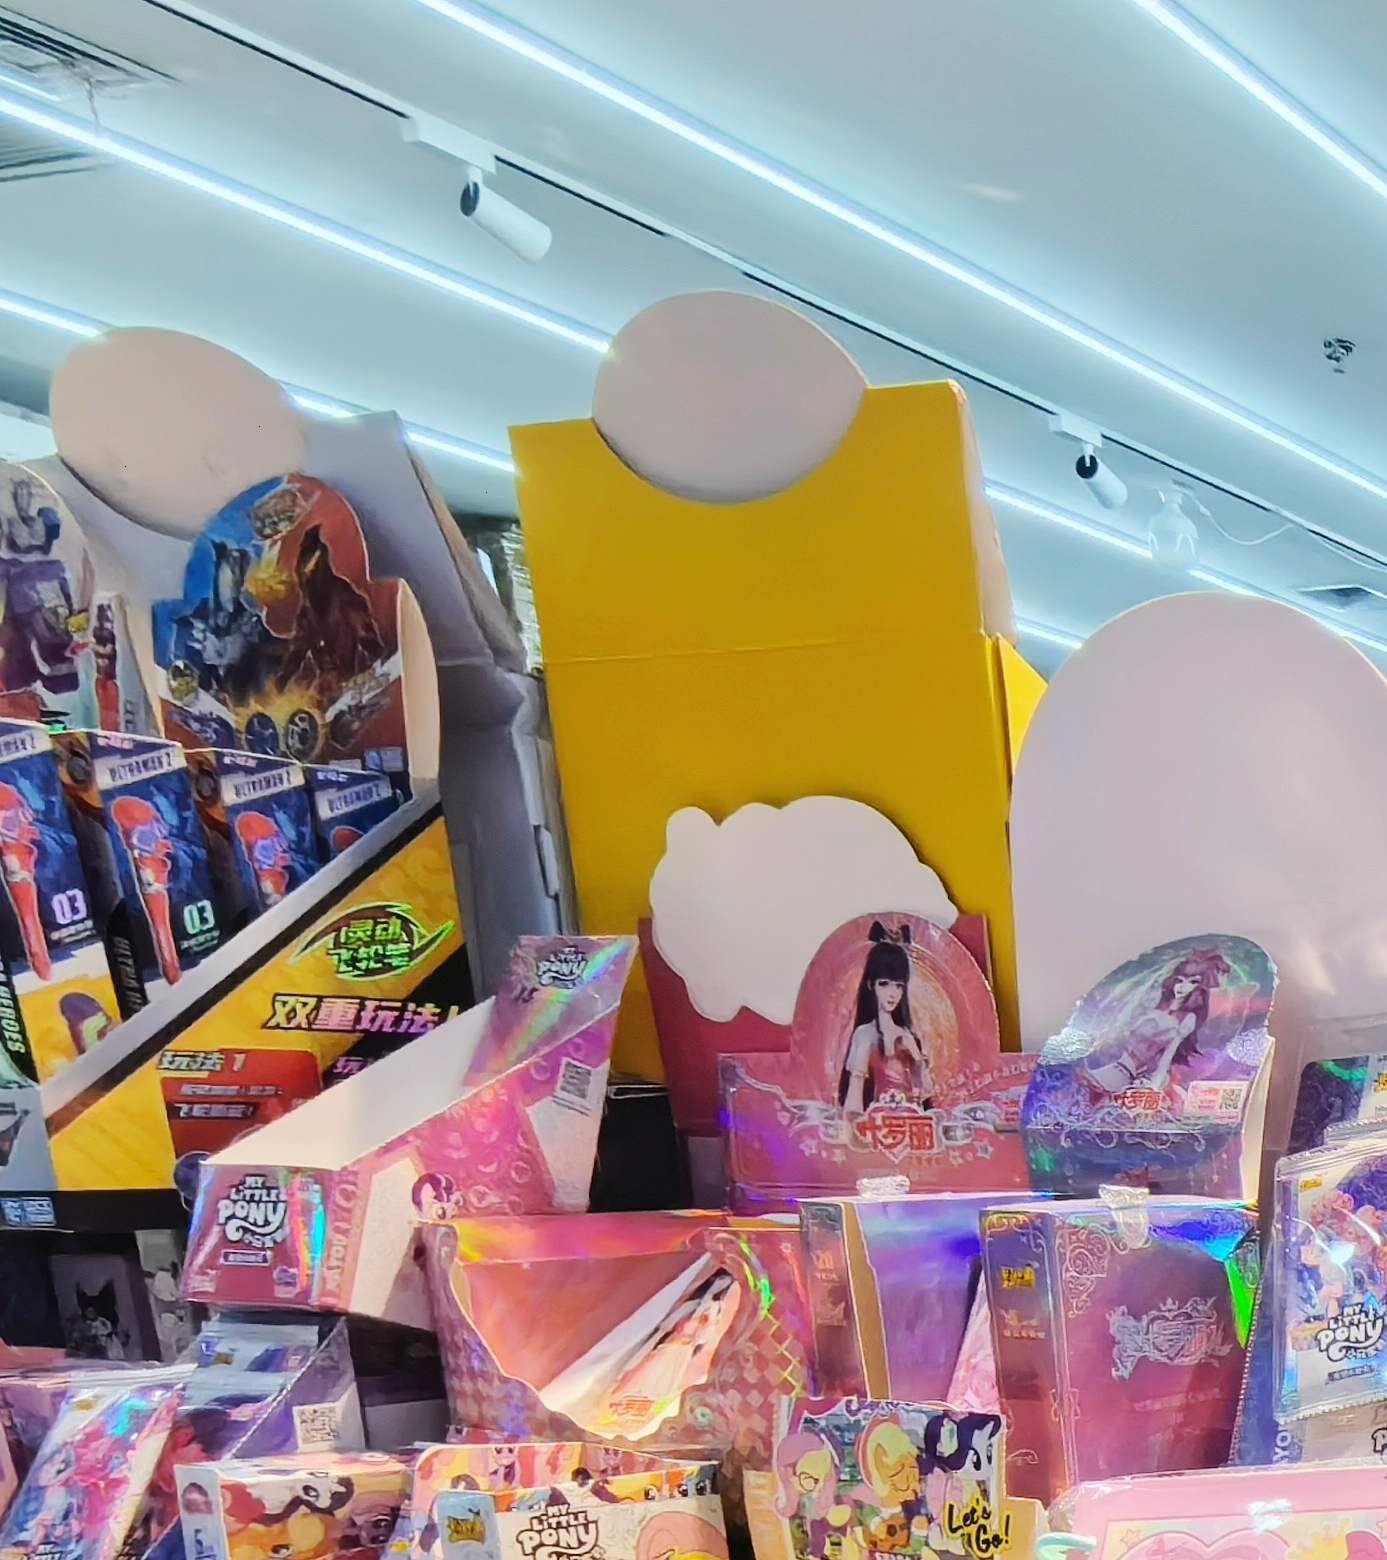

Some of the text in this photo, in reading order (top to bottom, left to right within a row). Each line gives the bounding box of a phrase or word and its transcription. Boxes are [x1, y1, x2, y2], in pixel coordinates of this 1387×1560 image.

[52, 887, 87, 924] 03
[183, 899, 215, 934] 03
[216, 1197, 288, 1231] PONY
[1316, 1317, 1385, 1352] PONY
[531, 1511, 589, 1530] LITTLE
[949, 1498, 992, 1536] Let's
[974, 1514, 1011, 1554] Go!
[517, 1521, 599, 1556] PONY
